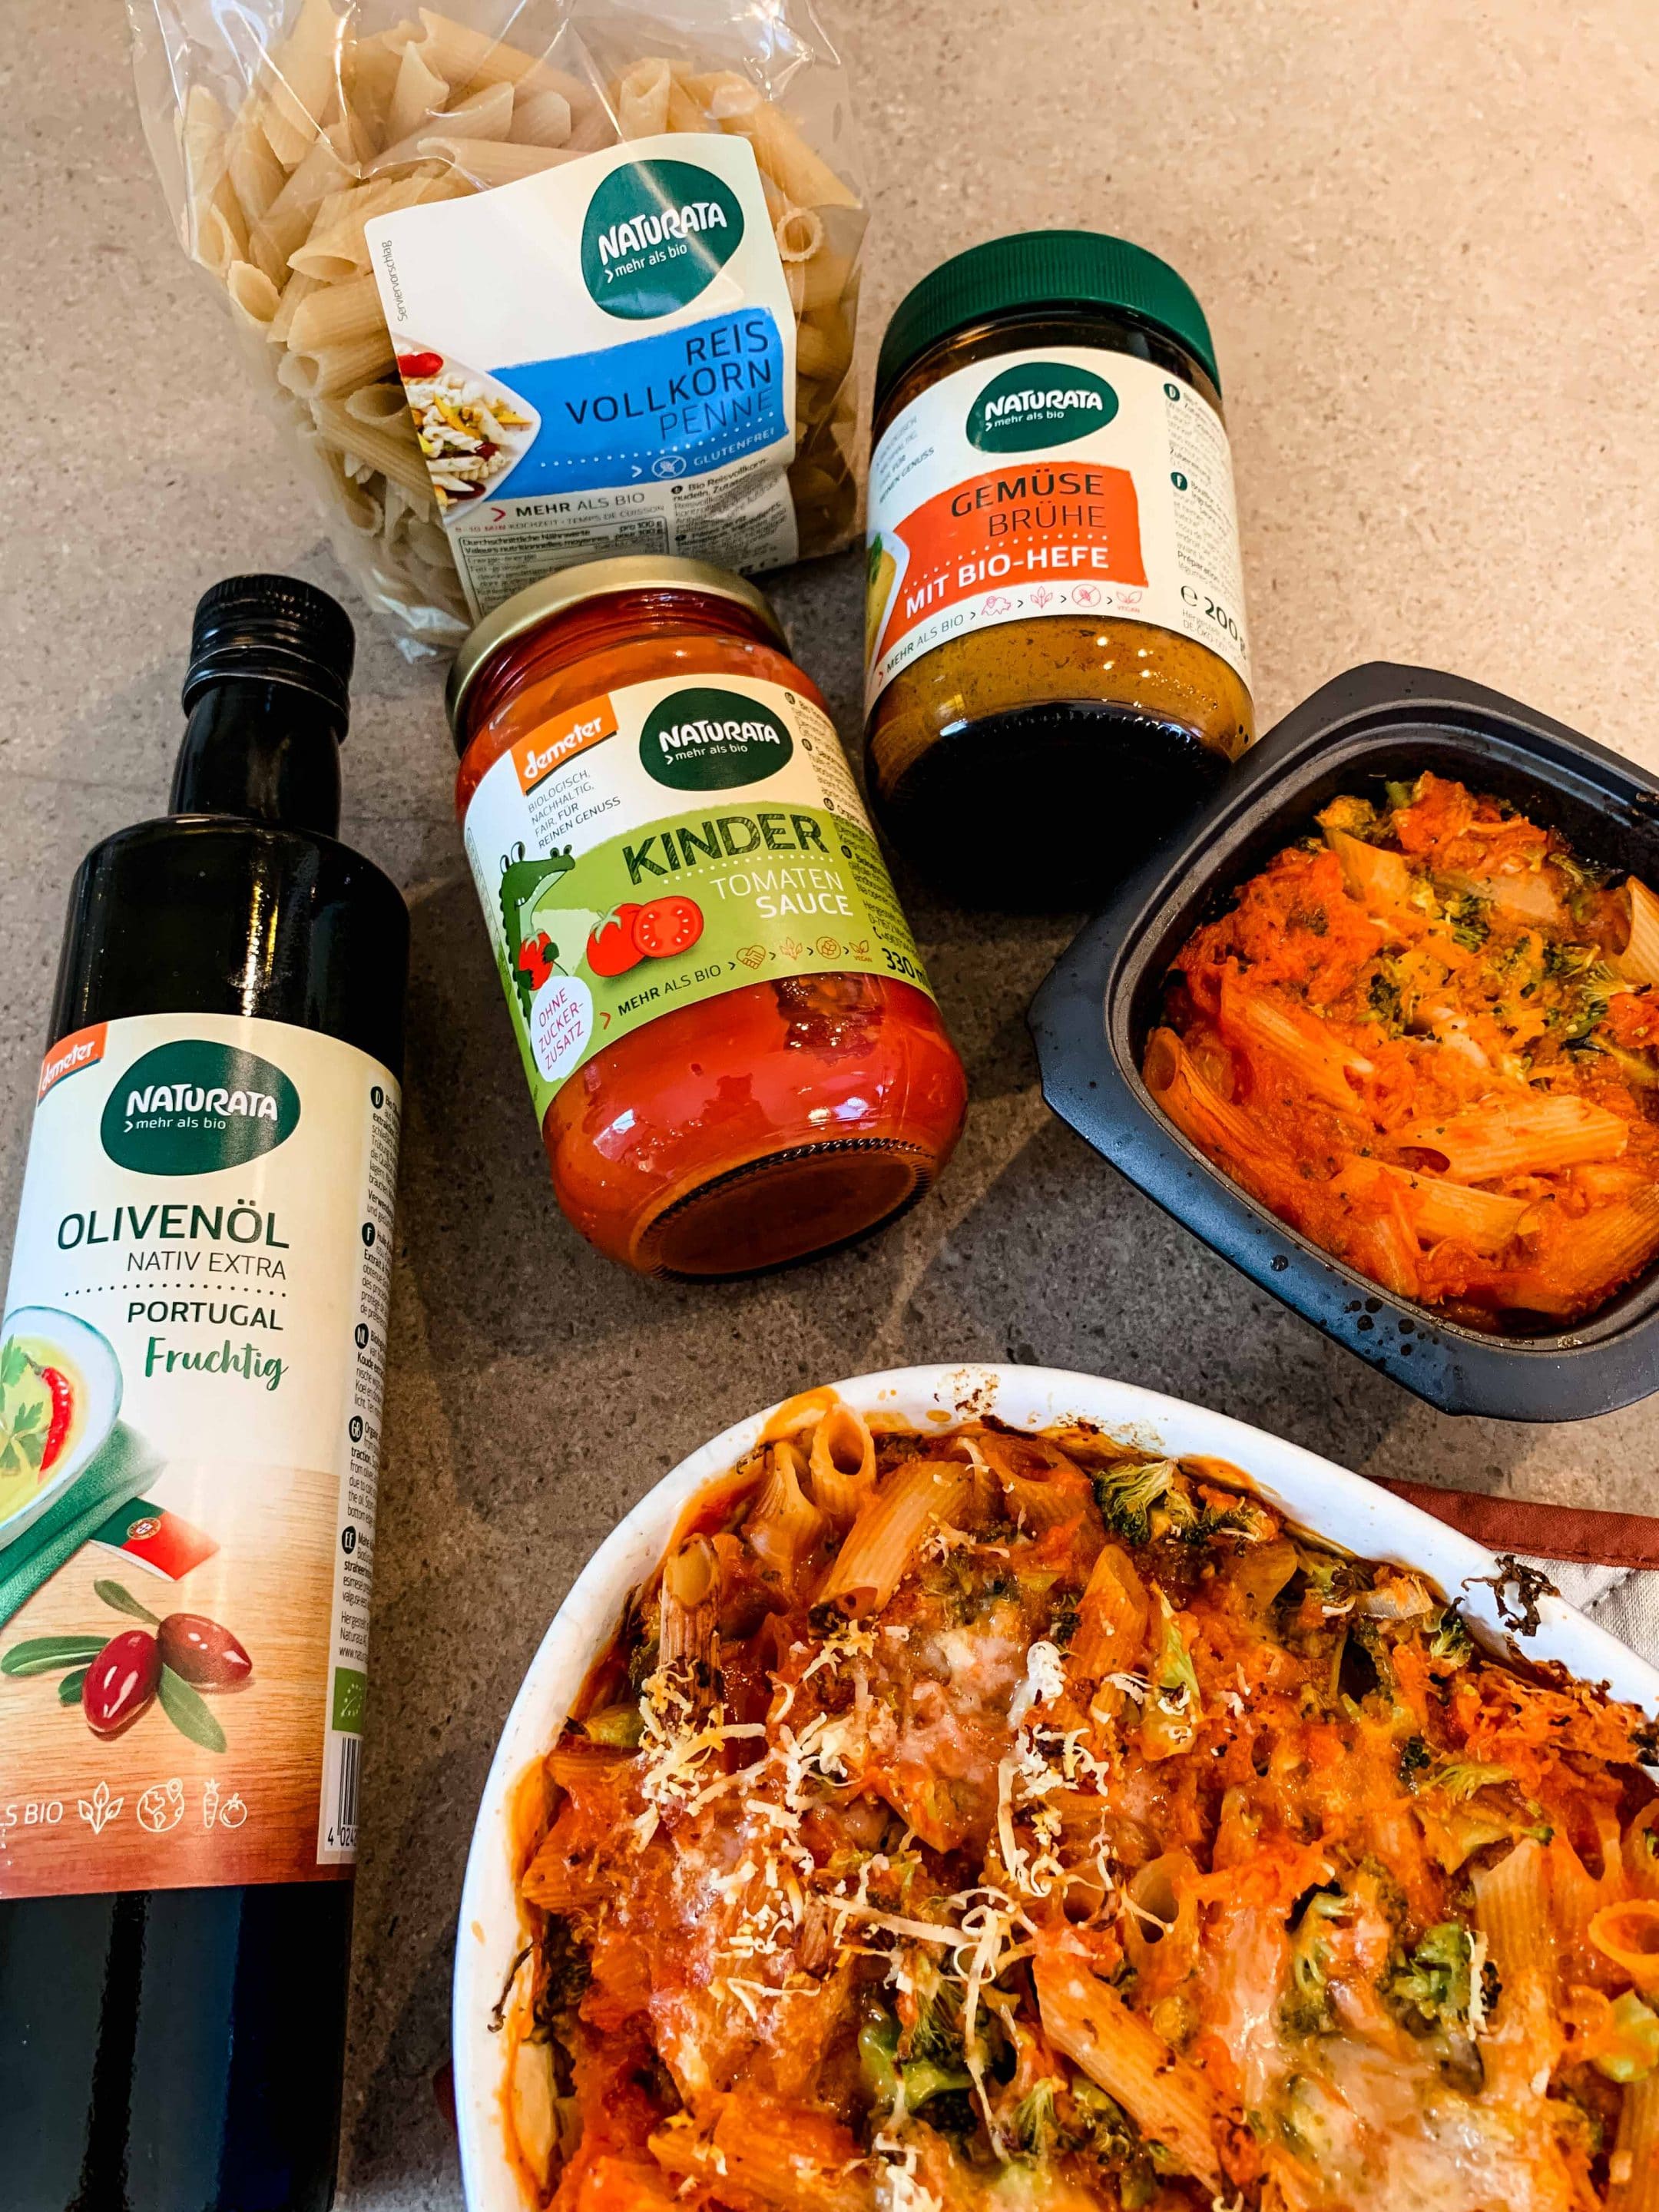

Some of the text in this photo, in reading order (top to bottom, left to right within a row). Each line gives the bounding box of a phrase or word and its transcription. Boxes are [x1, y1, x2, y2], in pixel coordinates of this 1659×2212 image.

[598, 203, 727, 264] NATURATA
[615, 243, 688, 278] mehr als bio
[382, 240, 408, 322] Serviervorschlag
[686, 320, 769, 366] REIS
[565, 359, 772, 425] VOLLKORN
[985, 390, 1103, 420] NATURATA
[659, 387, 773, 441] PENNE
[994, 409, 1065, 428] mehr als bio
[694, 427, 774, 465] GLUTENFREI
[516, 492, 645, 518] MEHR ALS BIO
[952, 469, 1104, 518] GEMÜSE
[988, 501, 1107, 538] BRÜHE
[905, 546, 1109, 619] MIT BIO-HEFE
[1204, 596, 1238, 641] 200
[886, 614, 964, 674] MEHR ALS BIO
[524, 717, 602, 778] demeter
[658, 720, 780, 753] NATURATA
[675, 742, 748, 762] mehr als bio
[538, 796, 621, 849] REINEN GENUSS
[558, 803, 579, 820] FÜR
[621, 813, 830, 886] KINDER
[710, 867, 843, 902] TOMATEN
[755, 893, 854, 919] SAUCE
[538, 988, 568, 1028] OHNE
[618, 965, 721, 1016] MEHR ALS BIO
[538, 1002, 584, 1054] ZUCKER-
[545, 1020, 584, 1071] ZUSATZ
[42, 1041, 95, 1091] demeter
[125, 1084, 279, 1121] NATURATA
[136, 1116, 227, 1131] mehr als bio
[57, 1198, 290, 1250] OLIVENÖL
[127, 1251, 286, 1280] NATIV EXTRA
[127, 1301, 283, 1330] PORTUGAL
[144, 1336, 290, 1391] Fruchtig
[349, 1474, 359, 1488] due
[349, 1489, 358, 1503] the
[0, 1802, 64, 1826] S BIO
